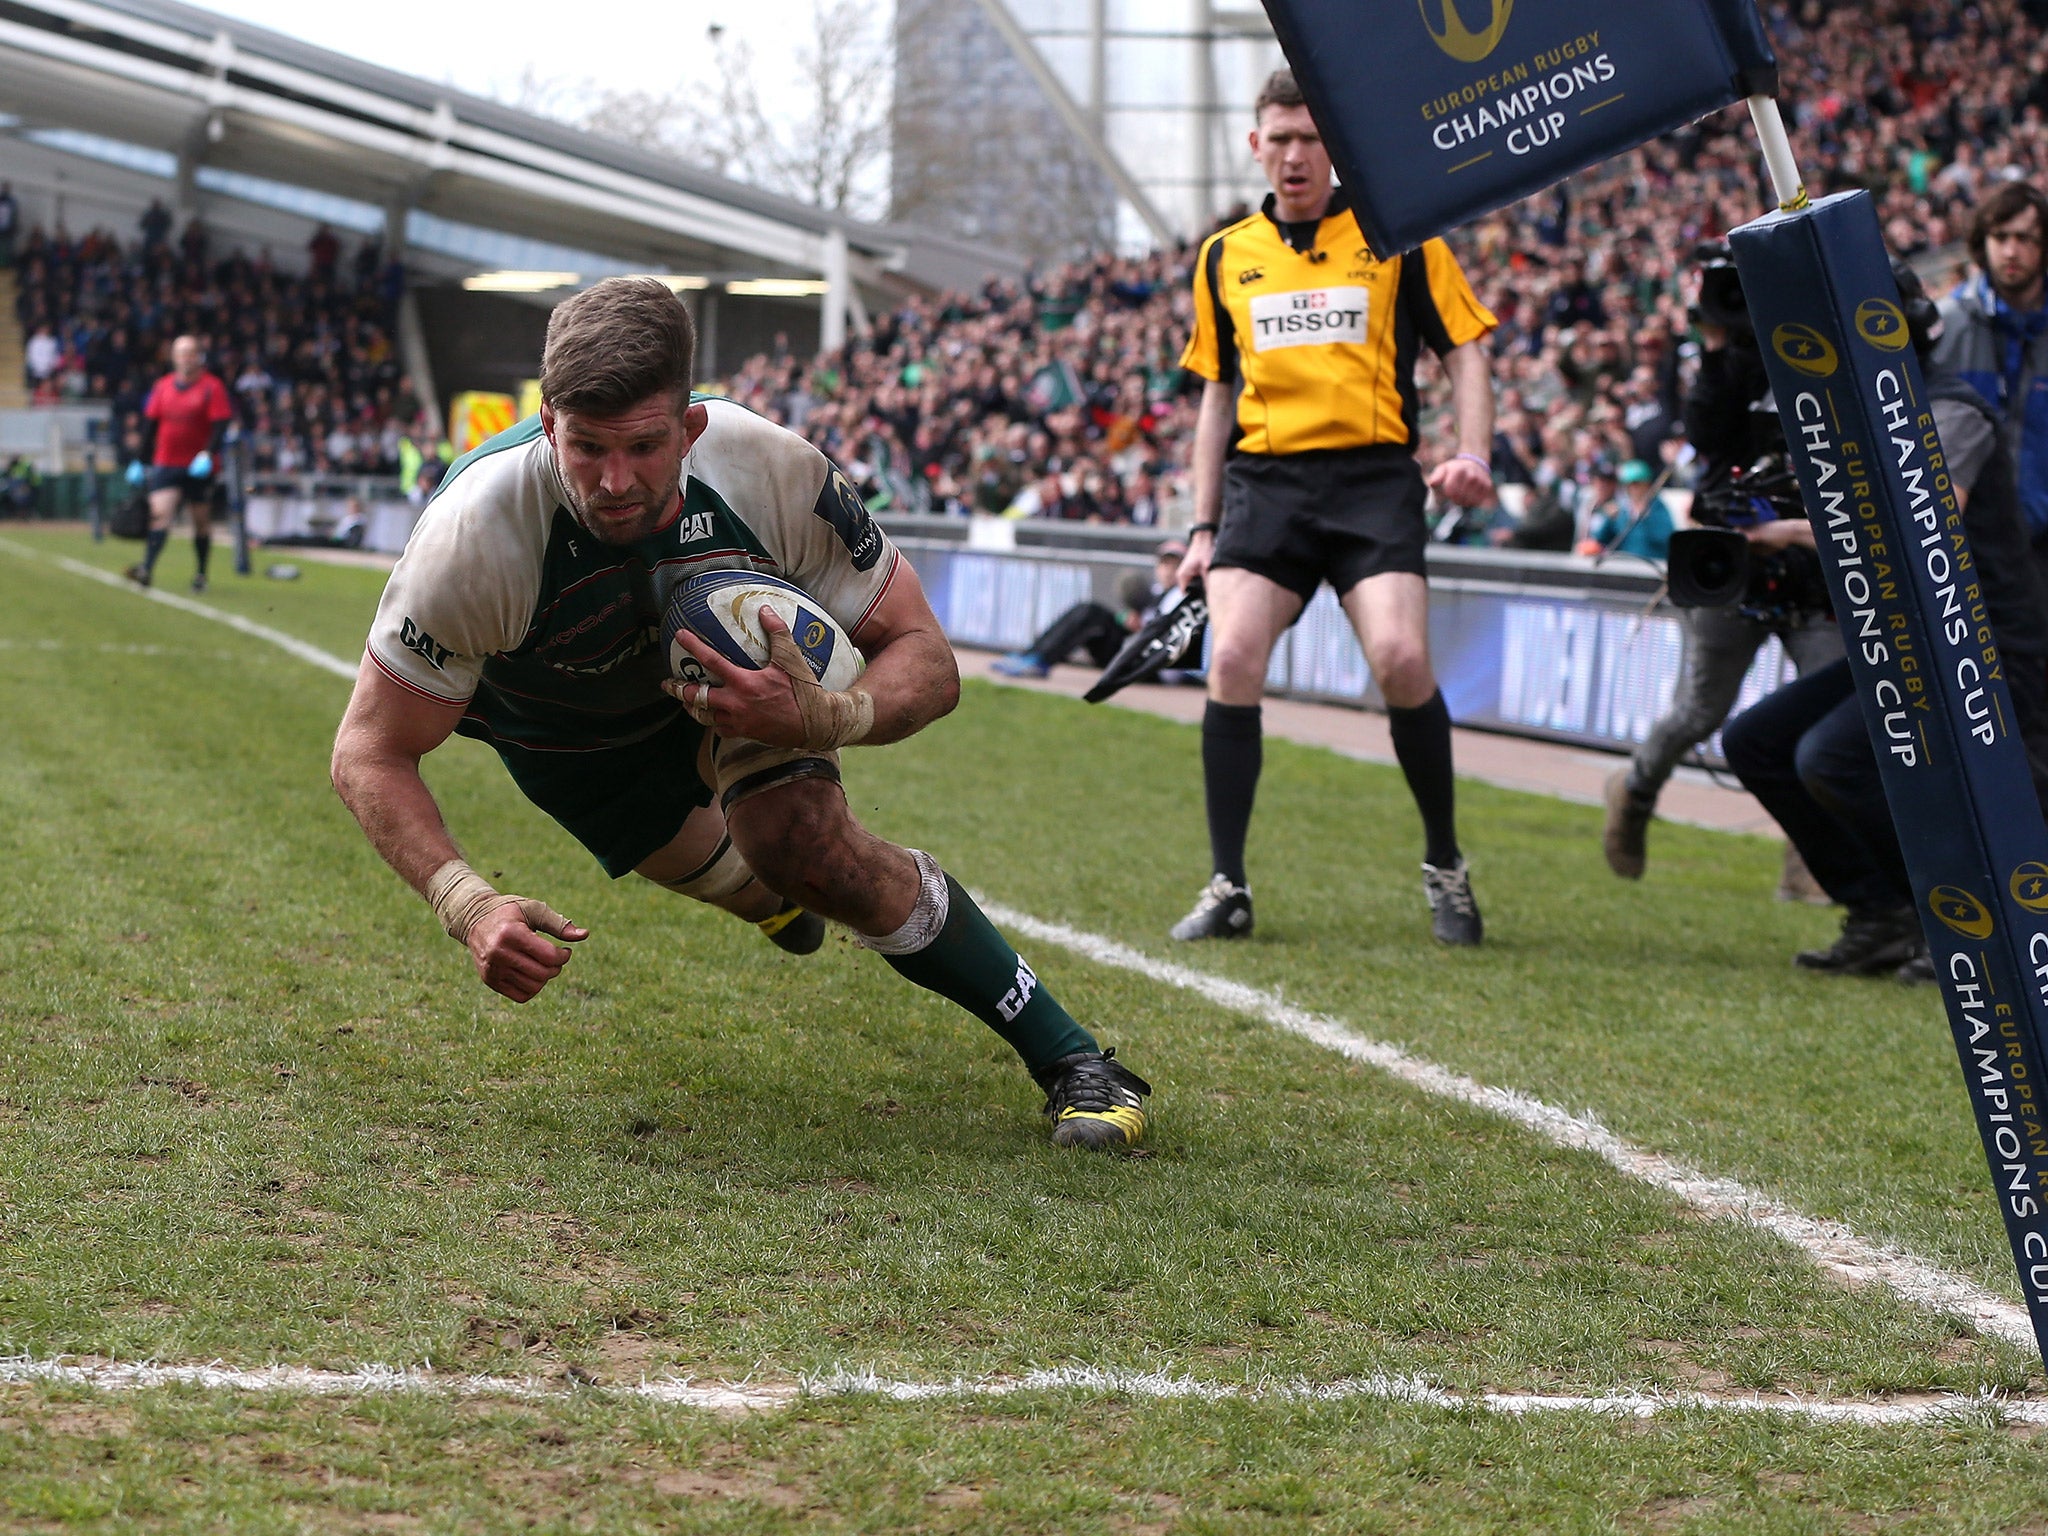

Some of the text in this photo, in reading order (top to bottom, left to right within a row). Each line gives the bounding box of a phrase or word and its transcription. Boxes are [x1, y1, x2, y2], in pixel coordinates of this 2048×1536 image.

[1422, 31, 1602, 120] EUROPEAN RUGBY
[1432, 53, 1617, 150] CHAMPIONS
[1506, 112, 1566, 155] CUP
[1257, 310, 1363, 335] TISSOT
[680, 511, 715, 544] CAT
[1795, 392, 1917, 768] CHAMPIONS CUP
[1841, 441, 1931, 712] EUROPEAN RUGBY
[1875, 369, 1996, 746] CHAMPIONS CUP
[1918, 412, 2003, 681] EUROPEAN RUGBY
[400, 616, 455, 671] CAT
[1950, 952, 2048, 1304] CHAMPIONS CU
[1994, 1003, 2048, 1157] EUROPEAN
